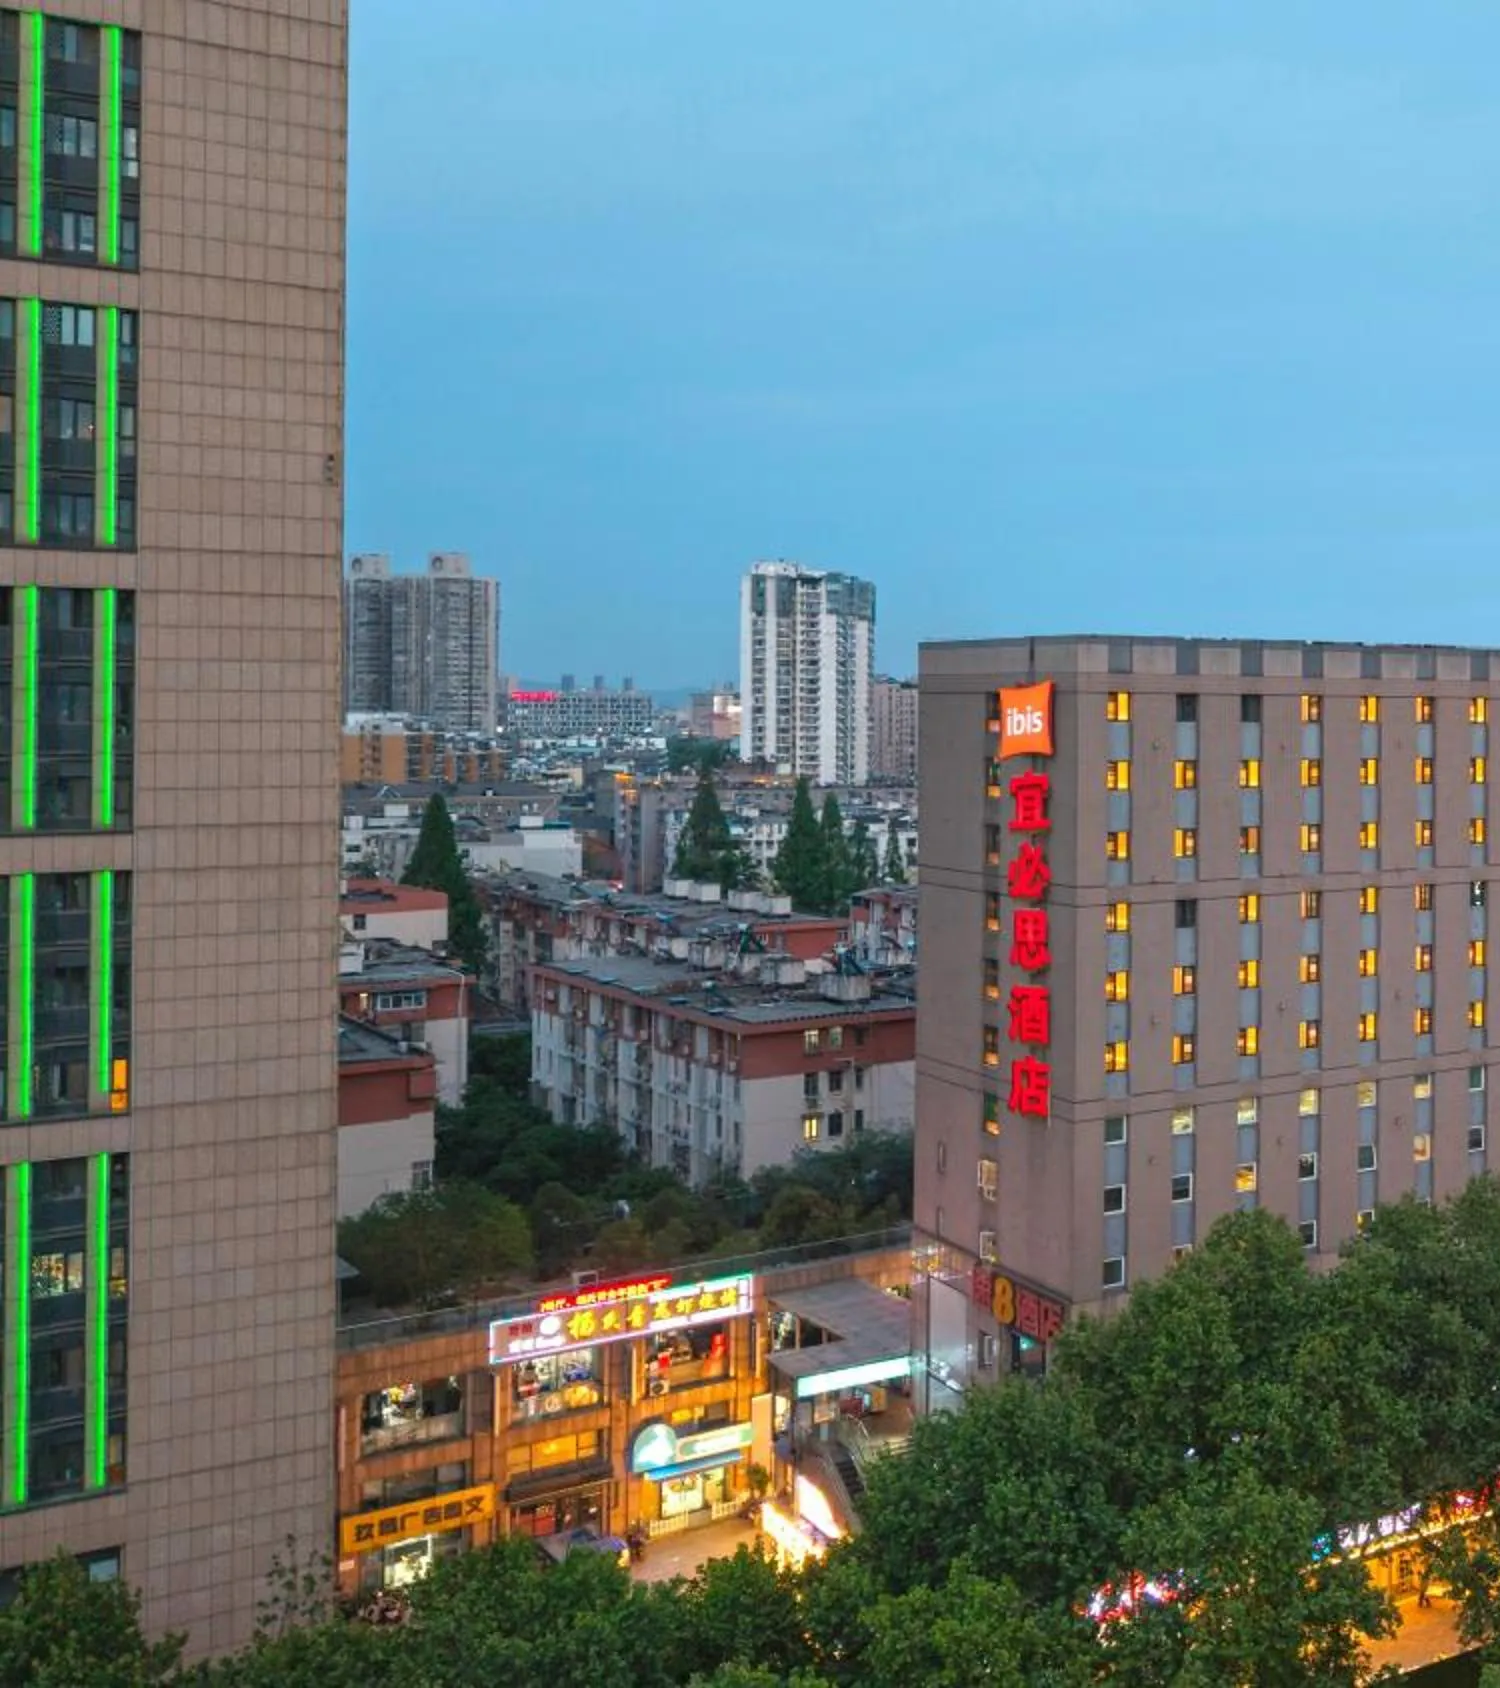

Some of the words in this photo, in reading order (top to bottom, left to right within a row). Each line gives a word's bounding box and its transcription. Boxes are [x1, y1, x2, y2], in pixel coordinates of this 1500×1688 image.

[1006, 705, 1043, 737] ibis
[1007, 770, 1051, 1117] 宜必思酒店
